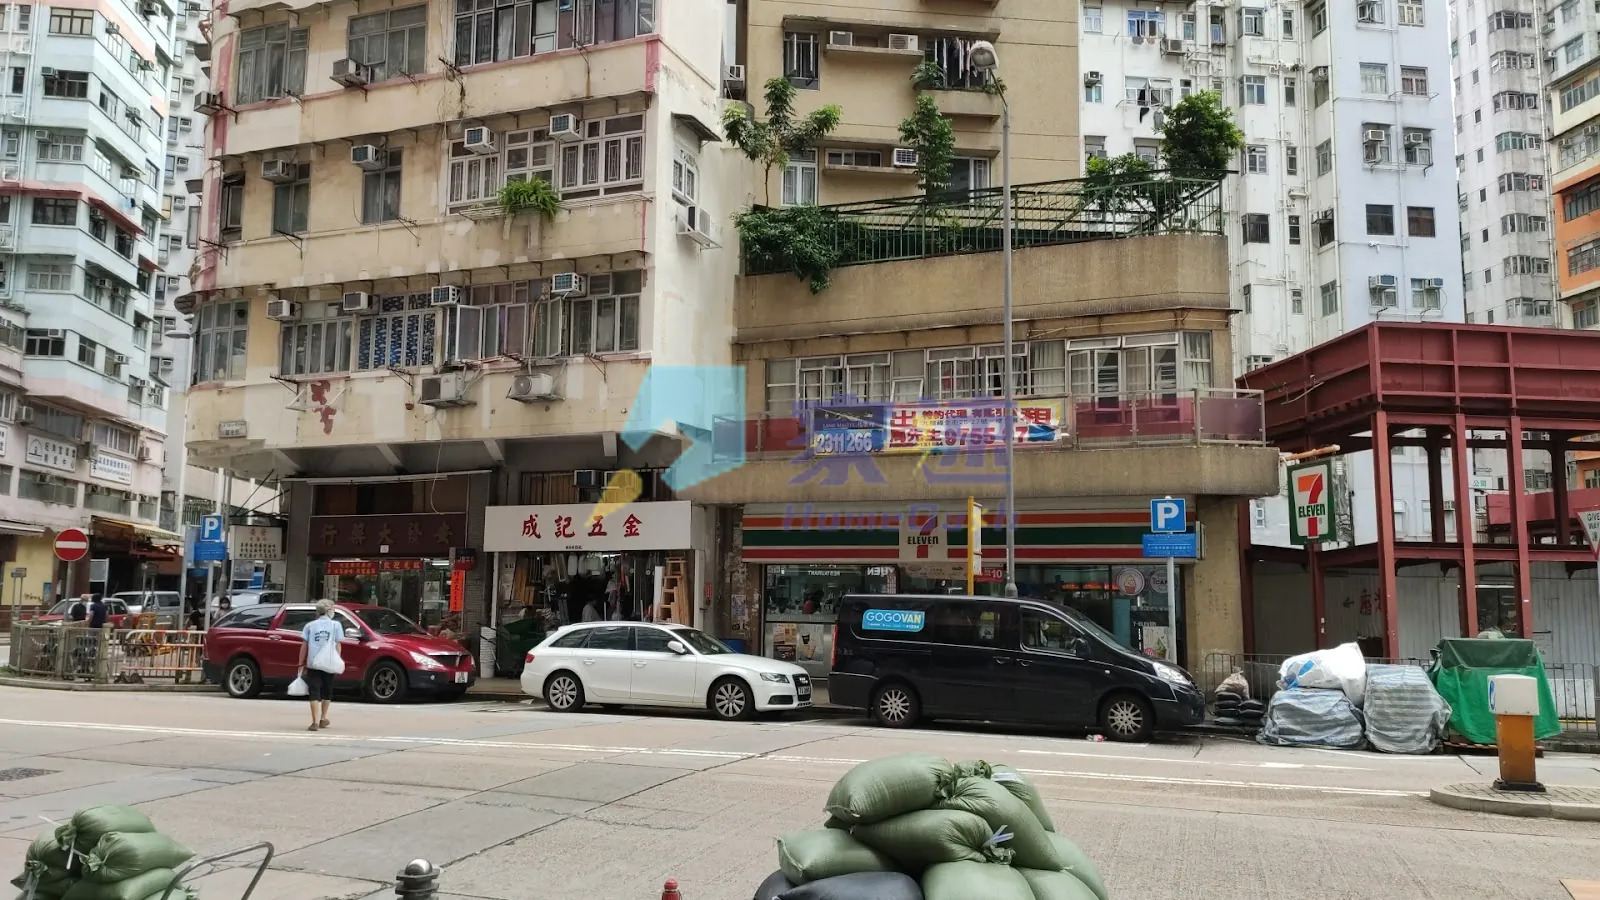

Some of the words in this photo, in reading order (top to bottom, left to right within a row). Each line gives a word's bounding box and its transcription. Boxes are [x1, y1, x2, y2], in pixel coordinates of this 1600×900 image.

[890, 410, 917, 427] 出
[944, 427, 996, 446] 9755
[1157, 502, 1179, 529] P
[1298, 473, 1324, 537] 7
[521, 513, 643, 539] 成記五金
[1587, 512, 1600, 521] GIVE
[204, 517, 219, 538] P
[908, 514, 938, 558] 7
[866, 611, 922, 624] GOGOVAN
